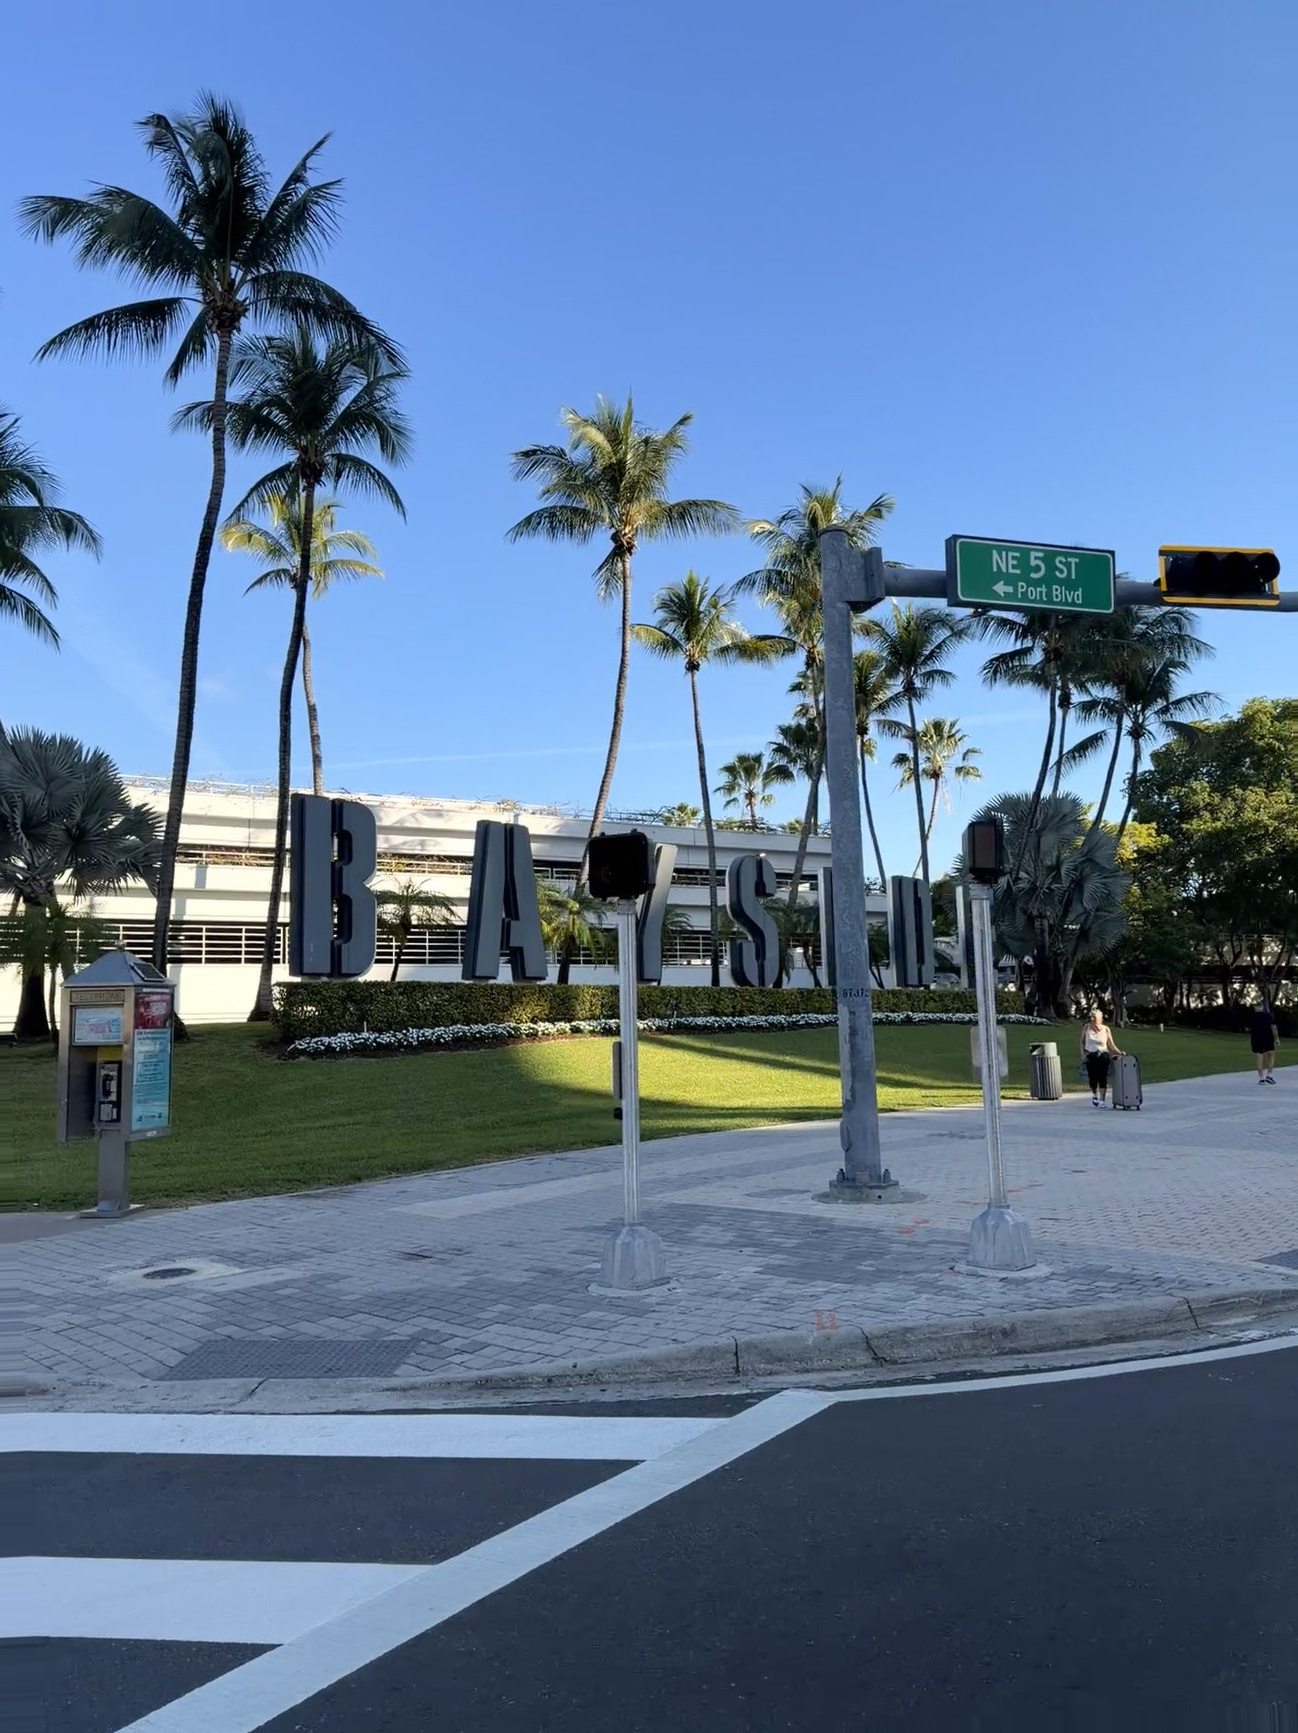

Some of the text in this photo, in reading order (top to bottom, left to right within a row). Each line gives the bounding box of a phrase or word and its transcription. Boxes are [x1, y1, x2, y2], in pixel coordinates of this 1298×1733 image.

[992, 550, 1080, 580] NE 5 ST
[1018, 583, 1082, 604] Port Blvd
[289, 792, 985, 988] BAYSD
